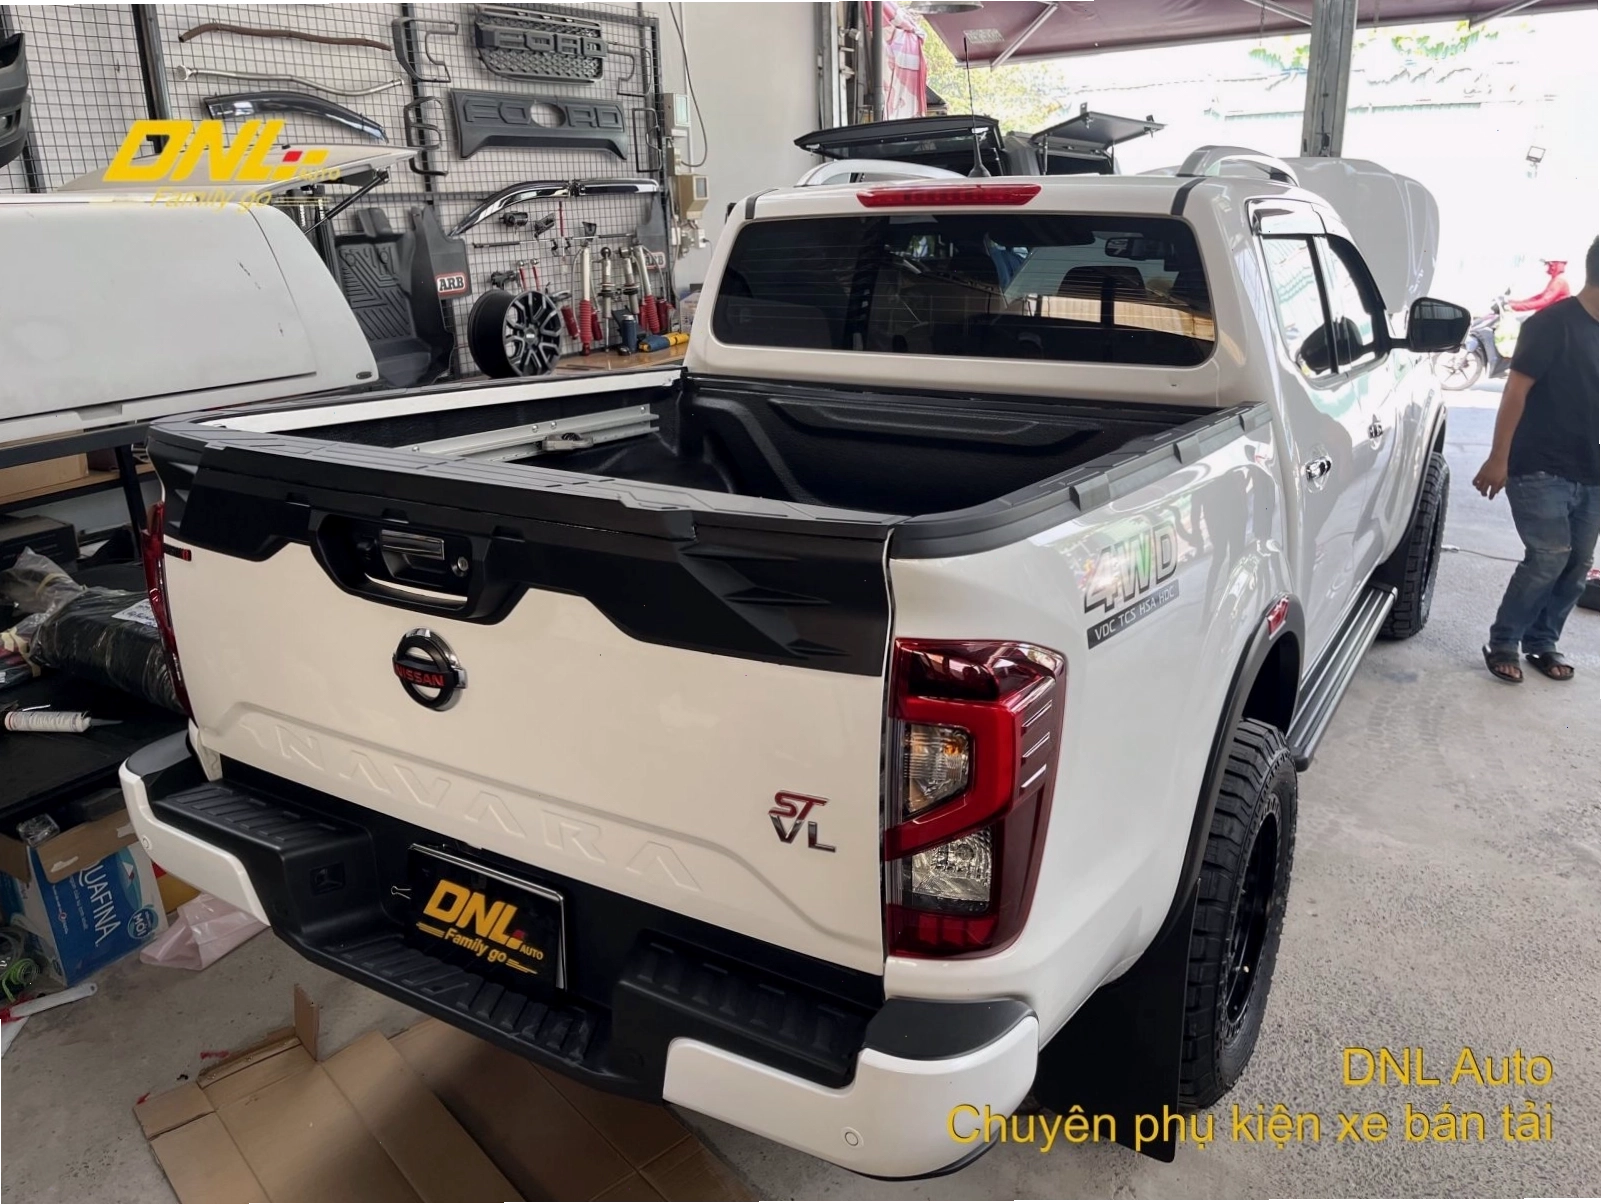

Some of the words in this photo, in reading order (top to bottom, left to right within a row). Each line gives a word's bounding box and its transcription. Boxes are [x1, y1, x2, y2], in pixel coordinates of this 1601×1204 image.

[463, 94, 625, 133] FORD
[438, 275, 465, 292] ARB
[1084, 521, 1178, 614] 4WD
[1094, 619, 1116, 640] VDC
[1118, 608, 1136, 627] TCS
[1139, 597, 1157, 616] HSA
[1158, 585, 1175, 605] HDC
[394, 663, 445, 687] NISSAN
[275, 724, 704, 893] NAVARA
[769, 814, 837, 853] VL
[444, 927, 490, 957] Family
[487, 948, 507, 962] go
[519, 944, 544, 960] AUTO
